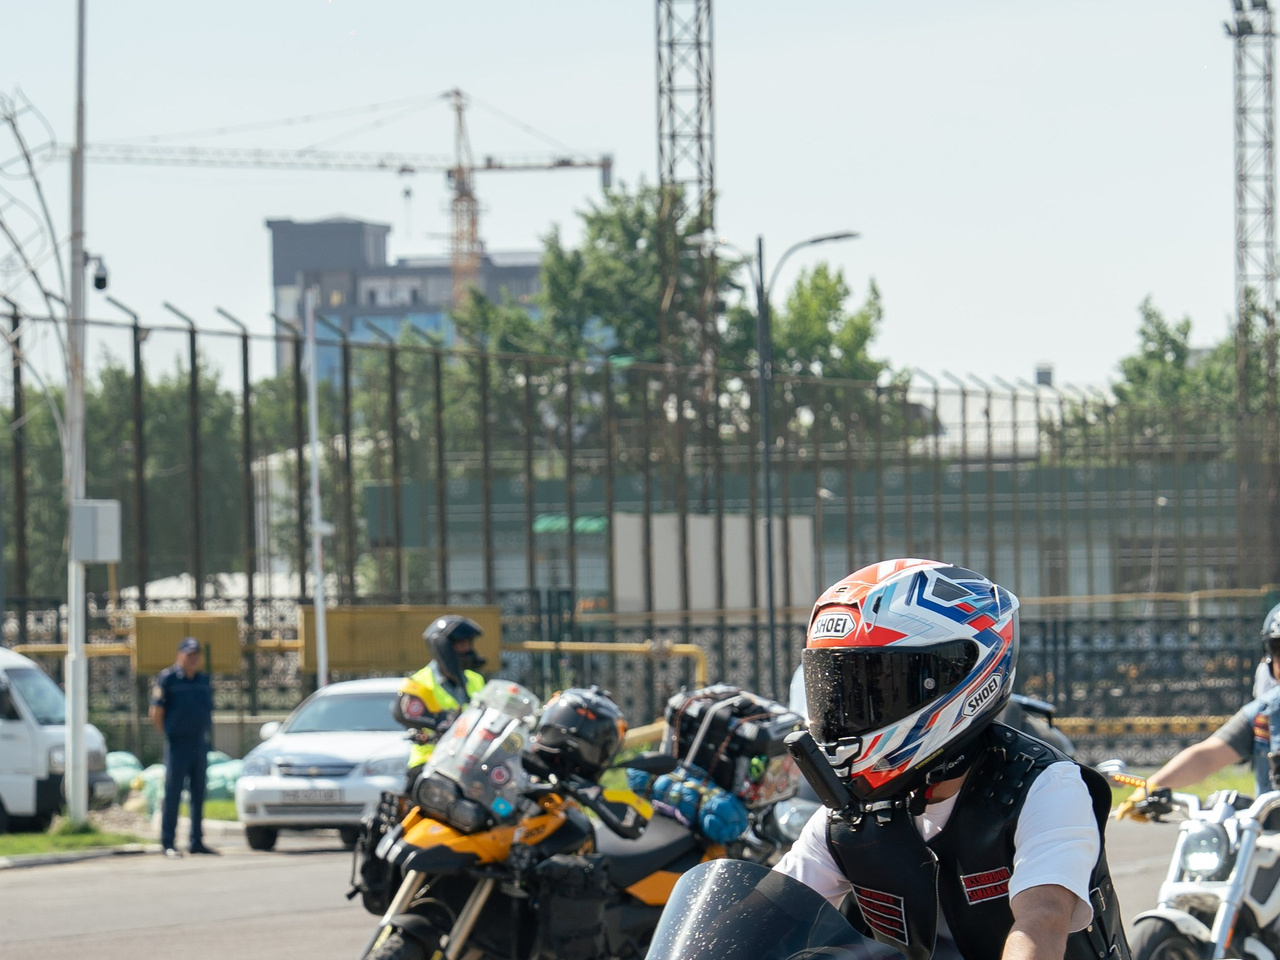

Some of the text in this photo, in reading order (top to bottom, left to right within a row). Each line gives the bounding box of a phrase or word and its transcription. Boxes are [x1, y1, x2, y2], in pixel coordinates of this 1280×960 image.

[815, 618, 848, 634] SHOEI
[968, 677, 998, 713] SHOEI
[967, 882, 1009, 902] SAMARKAN
